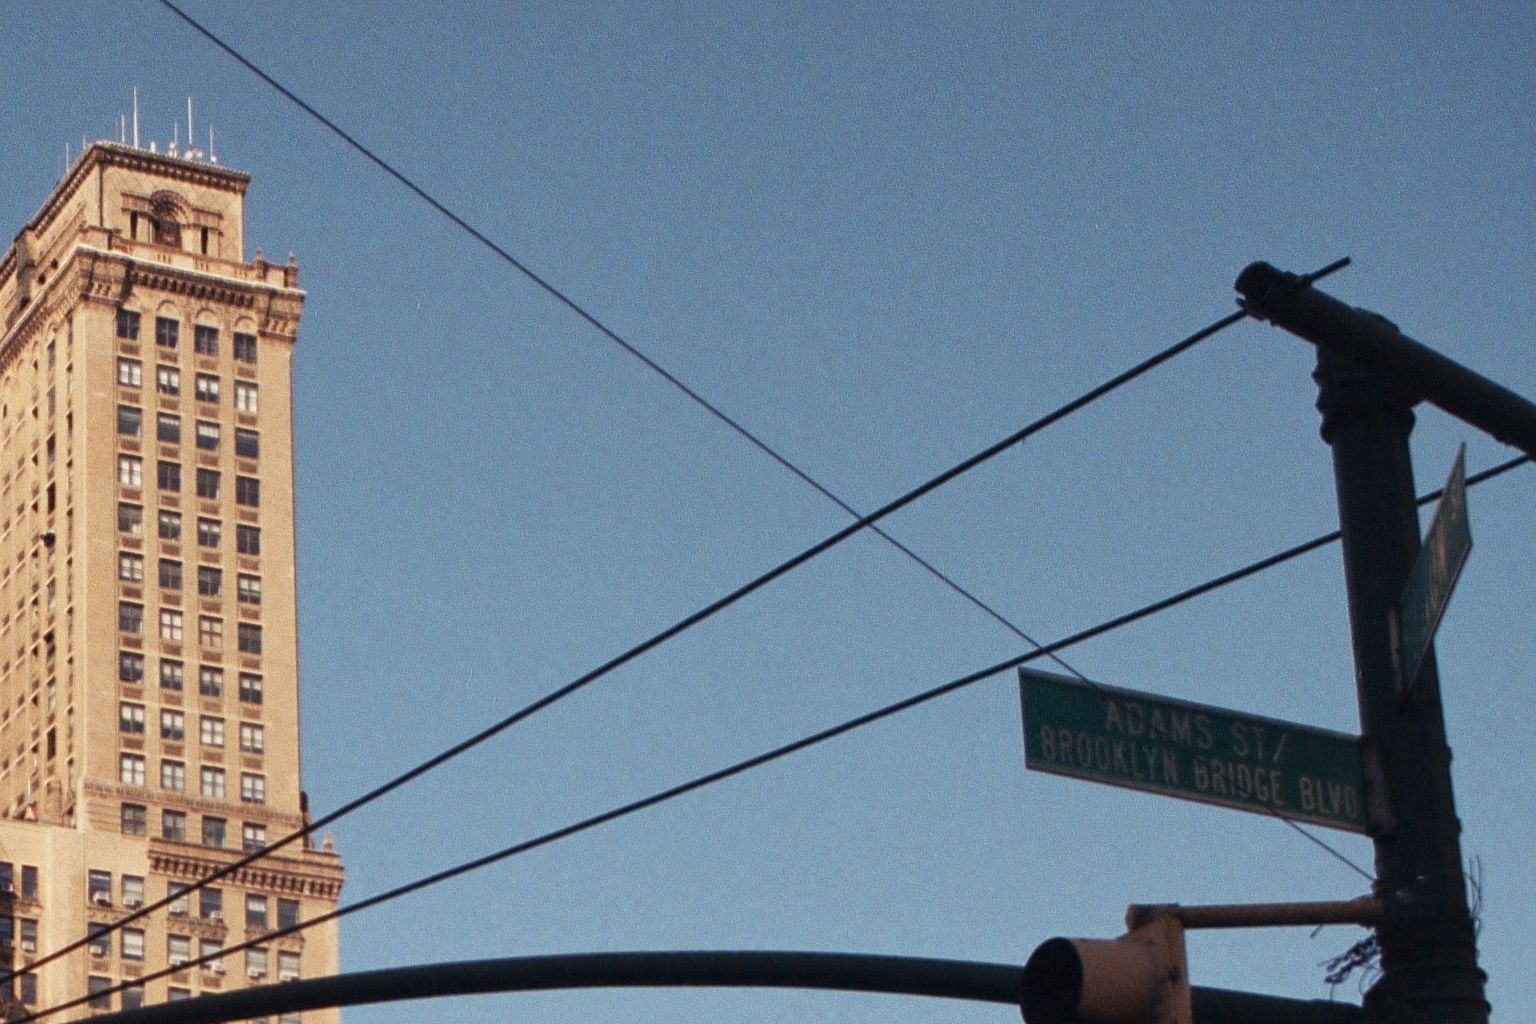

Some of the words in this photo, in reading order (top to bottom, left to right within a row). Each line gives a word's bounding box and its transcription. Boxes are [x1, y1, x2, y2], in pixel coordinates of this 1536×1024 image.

[1105, 700, 1213, 750] ADAMS
[1040, 725, 1178, 785] BROOKLYN
[1193, 755, 1282, 806] BRIDGE
[1299, 776, 1359, 819] BLVD
